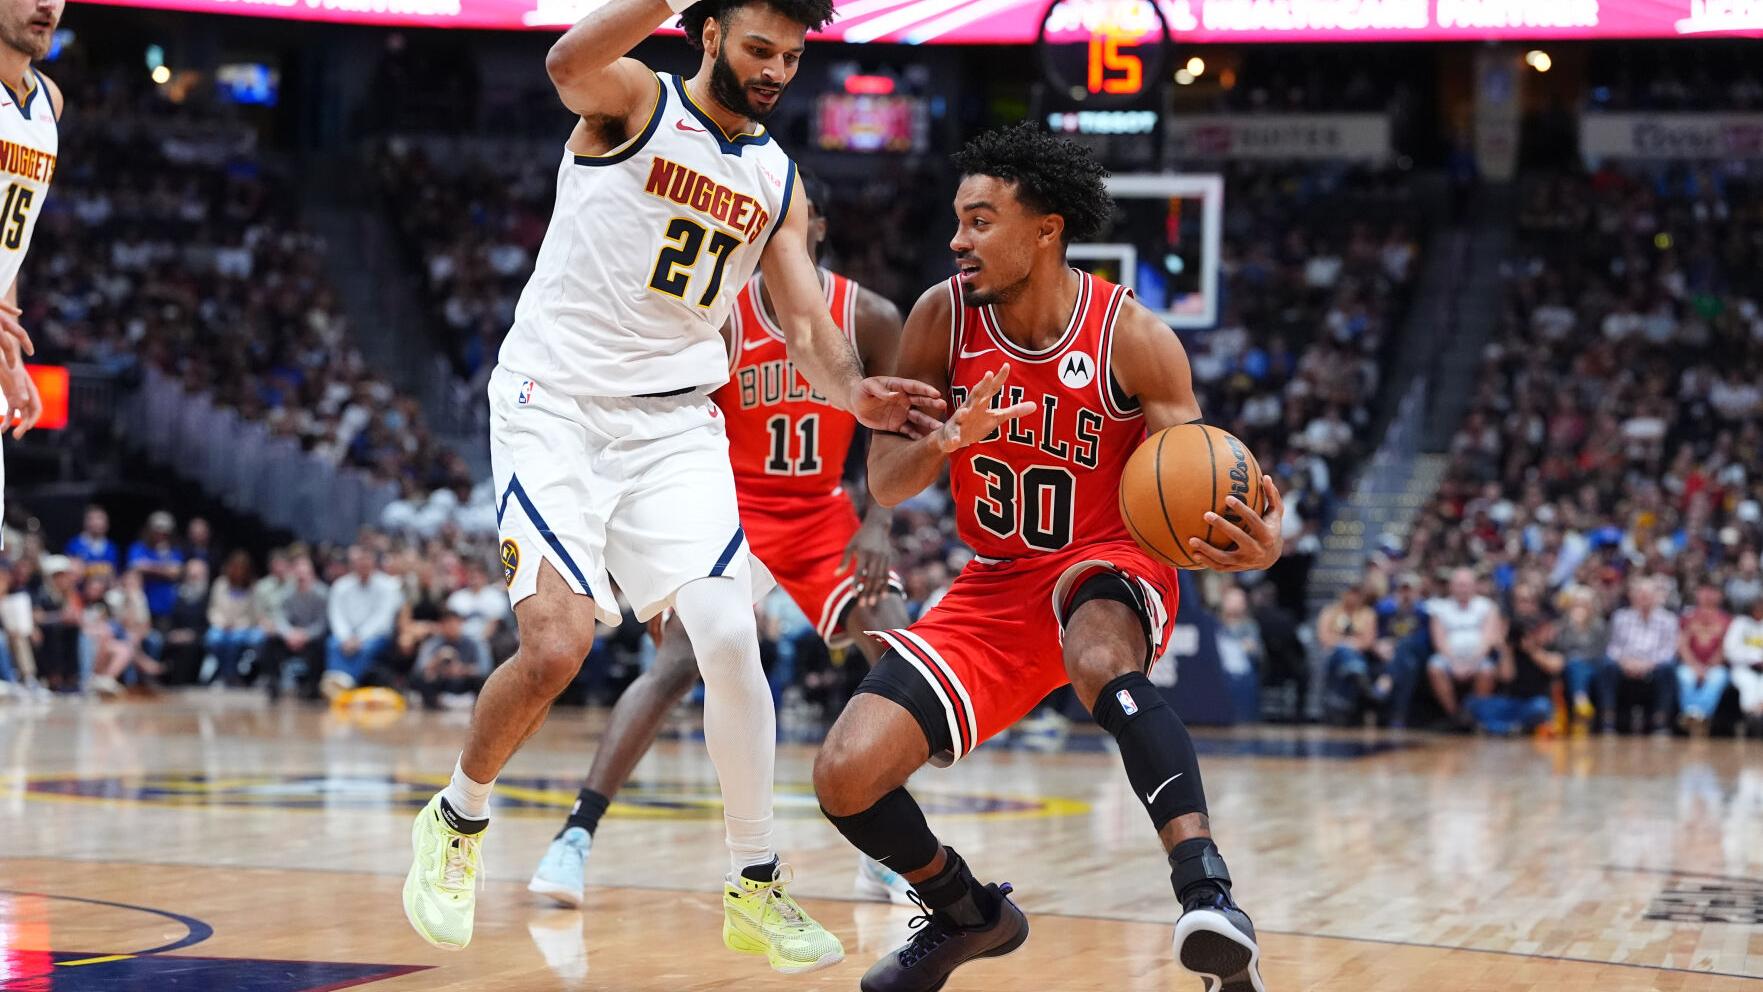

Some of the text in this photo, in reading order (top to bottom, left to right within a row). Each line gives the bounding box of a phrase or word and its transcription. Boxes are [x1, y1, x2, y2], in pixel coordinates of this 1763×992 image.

[1088, 31, 1143, 94] 15
[0, 182, 35, 250] 15
[645, 156, 769, 245] NUGGETS
[648, 217, 745, 309] 27
[736, 359, 831, 410] BUL
[764, 413, 822, 476] 11
[970, 453, 1076, 552] 30
